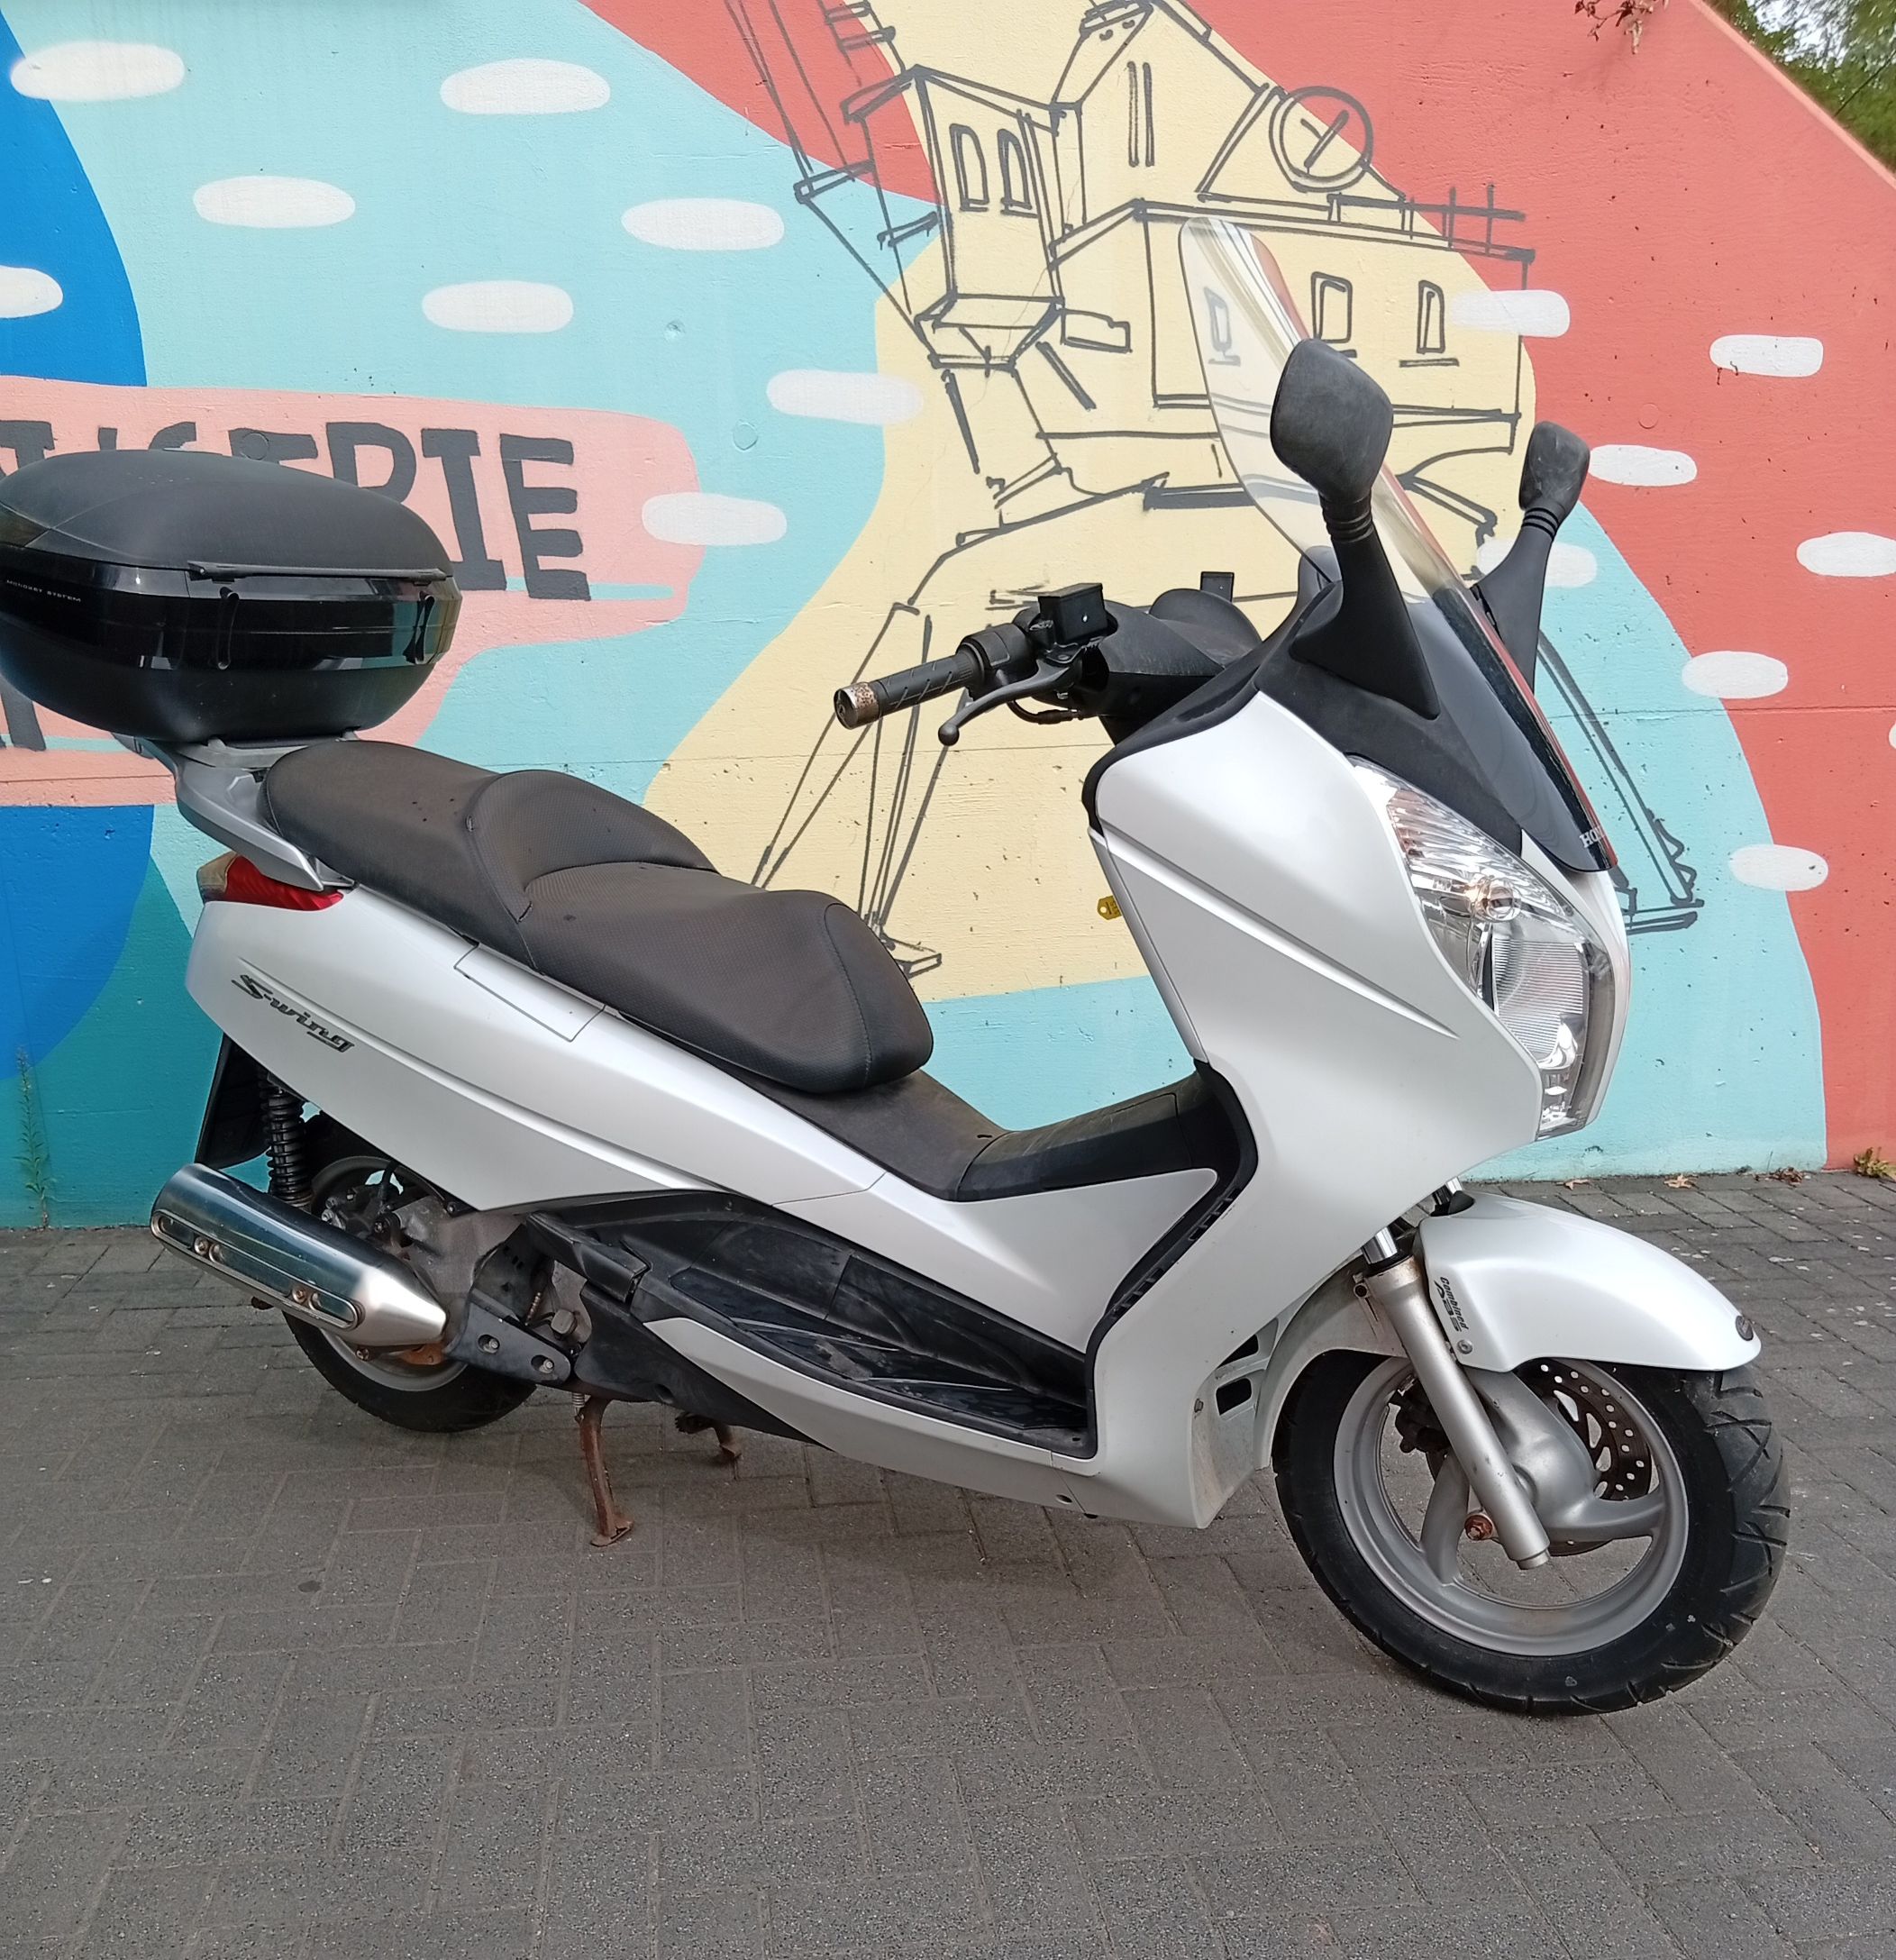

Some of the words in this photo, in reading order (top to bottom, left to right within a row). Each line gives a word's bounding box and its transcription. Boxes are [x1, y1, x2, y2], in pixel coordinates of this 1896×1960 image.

[47, 590, 81, 602] SYSTEM
[1434, 1280, 1463, 1332] ABS
[1440, 1276, 1469, 1330] Combined
